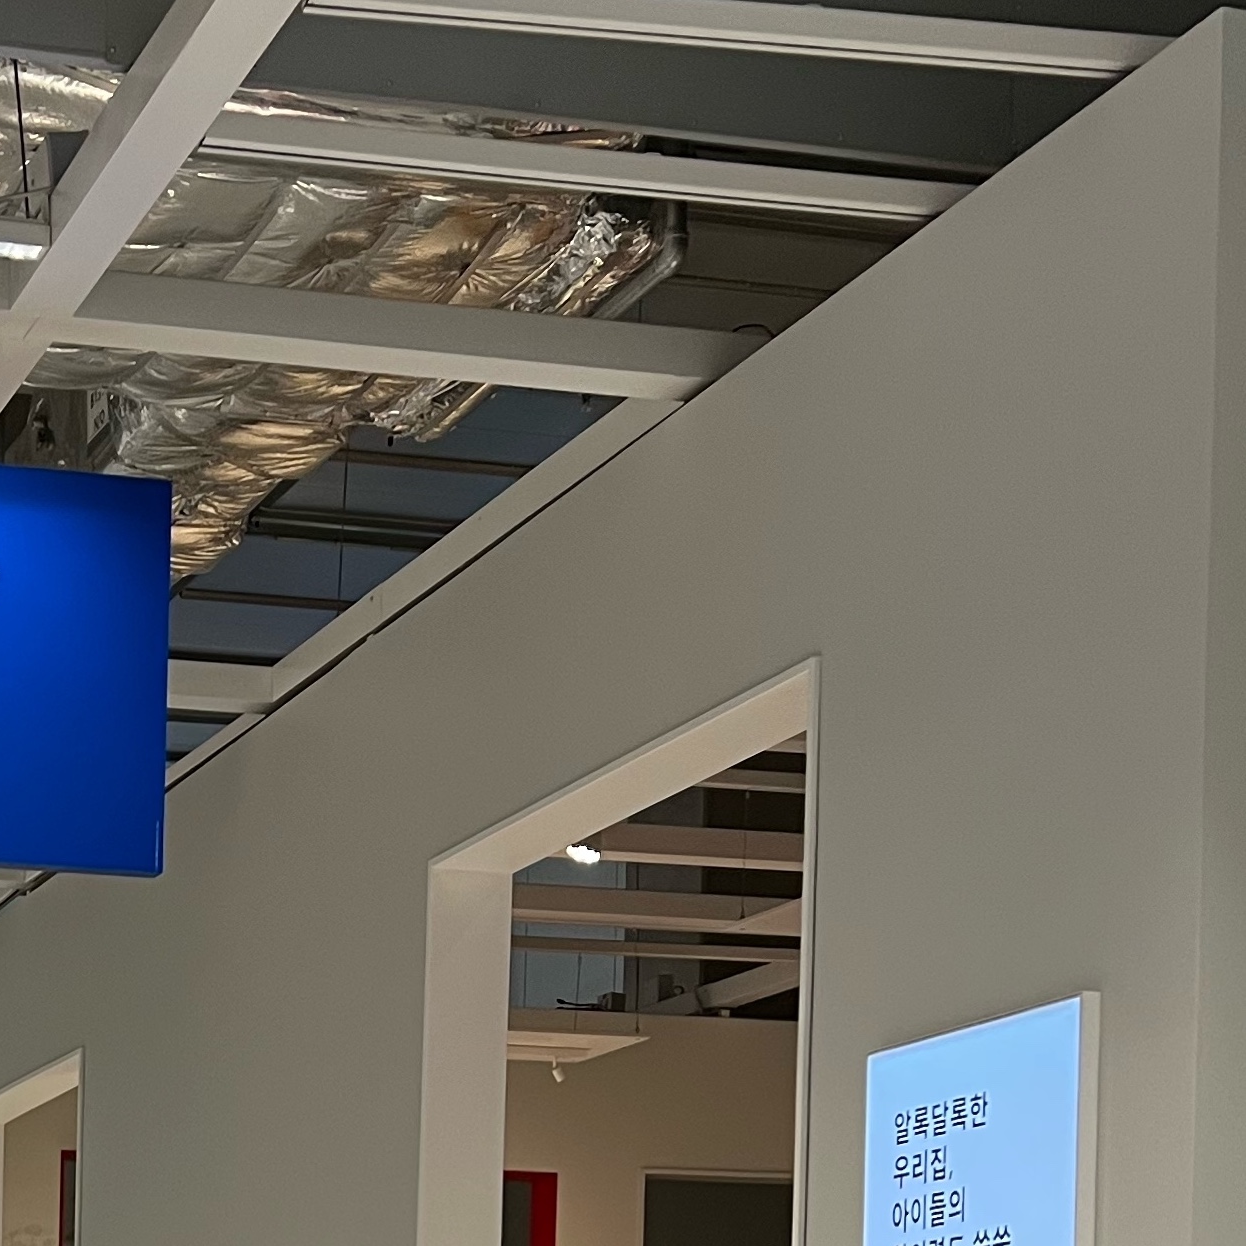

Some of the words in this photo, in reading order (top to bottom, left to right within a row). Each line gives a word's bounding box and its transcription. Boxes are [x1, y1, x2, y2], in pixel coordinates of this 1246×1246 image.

[894, 1091, 988, 1146] 알록달록한
[893, 1145, 953, 1190] 우리집,
[892, 1186, 965, 1234] 아이들의
